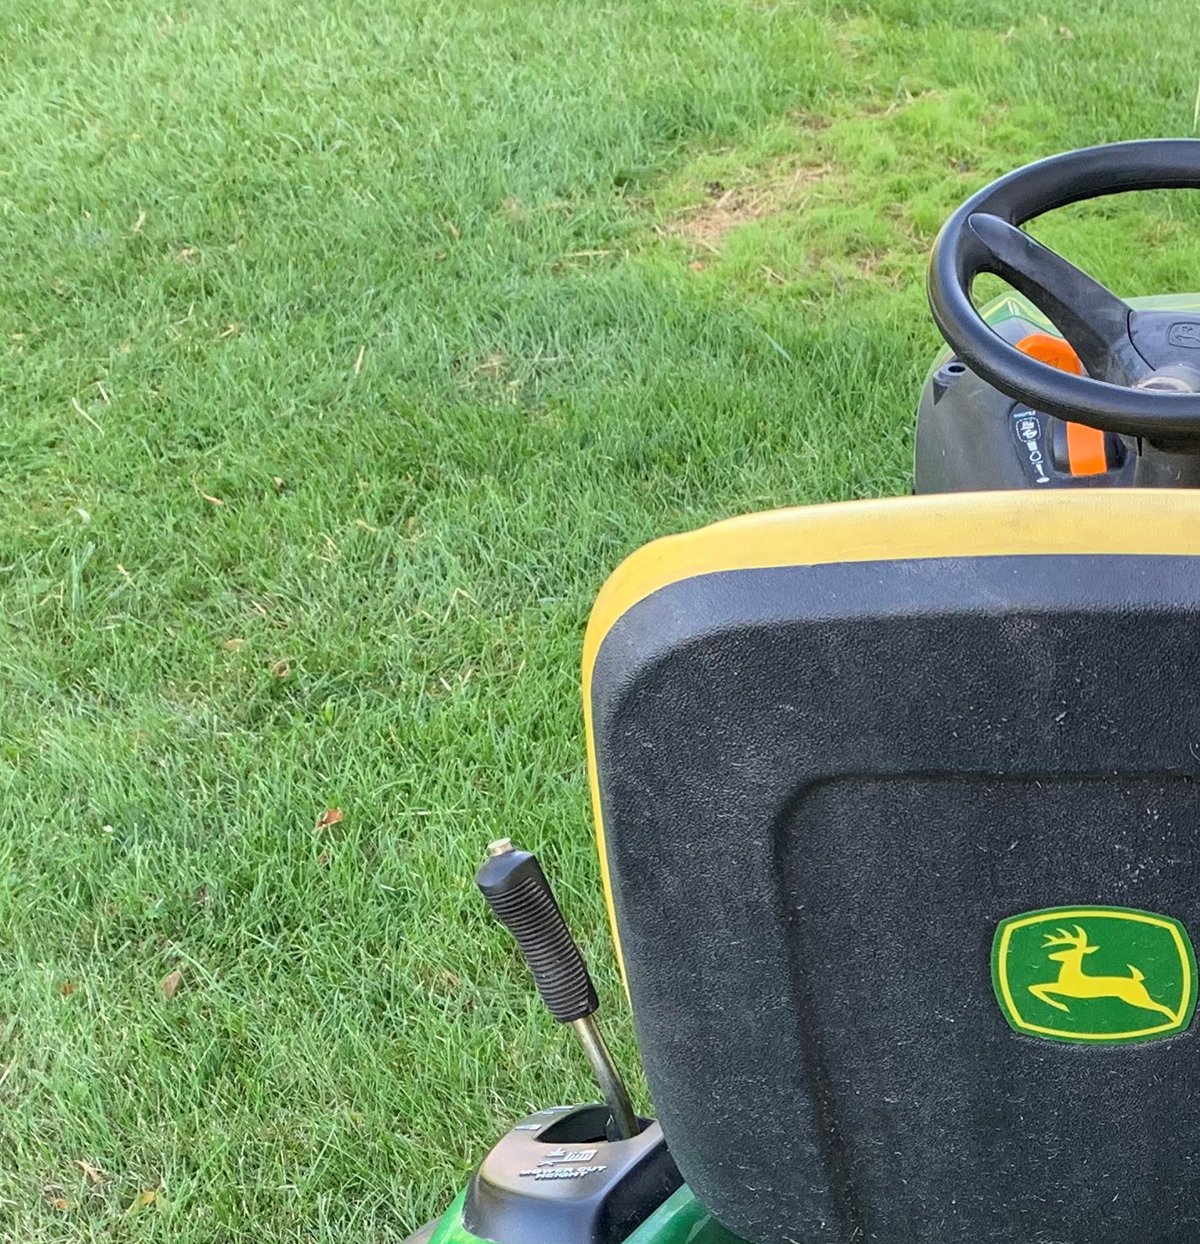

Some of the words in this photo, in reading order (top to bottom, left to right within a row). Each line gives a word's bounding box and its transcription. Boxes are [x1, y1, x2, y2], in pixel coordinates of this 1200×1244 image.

[519, 1167, 573, 1177] MOWER
[576, 1165, 607, 1173] CUT
[534, 1171, 589, 1181] HEIGHT
